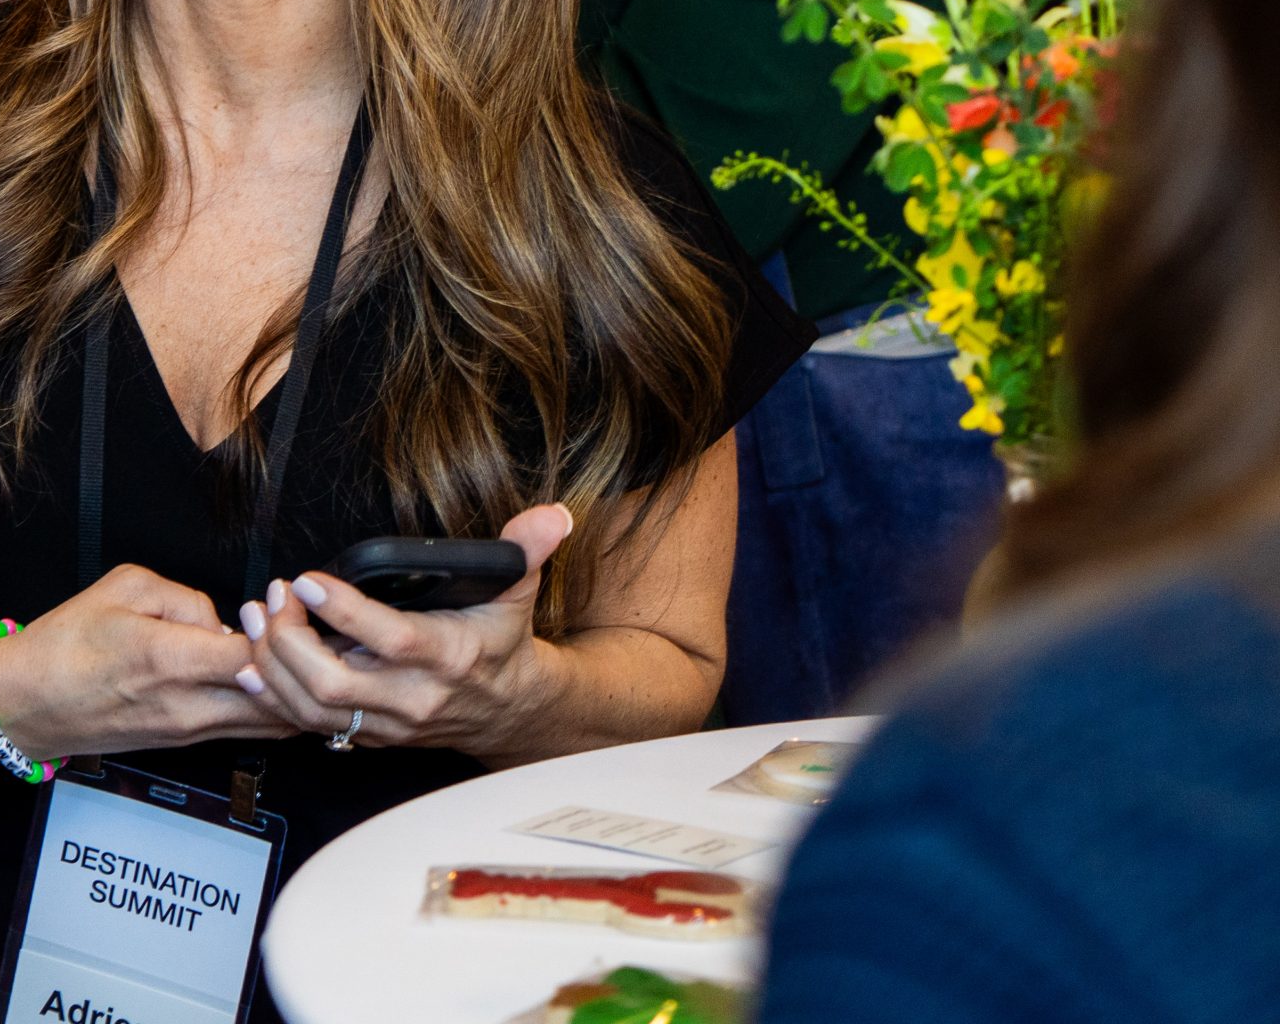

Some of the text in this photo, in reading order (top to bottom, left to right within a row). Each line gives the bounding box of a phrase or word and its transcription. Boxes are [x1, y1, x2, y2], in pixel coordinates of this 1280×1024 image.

[60, 840, 240, 915] DESTINATION
[89, 879, 202, 932] SUMMIT
[39, 989, 132, 1024] Adri
